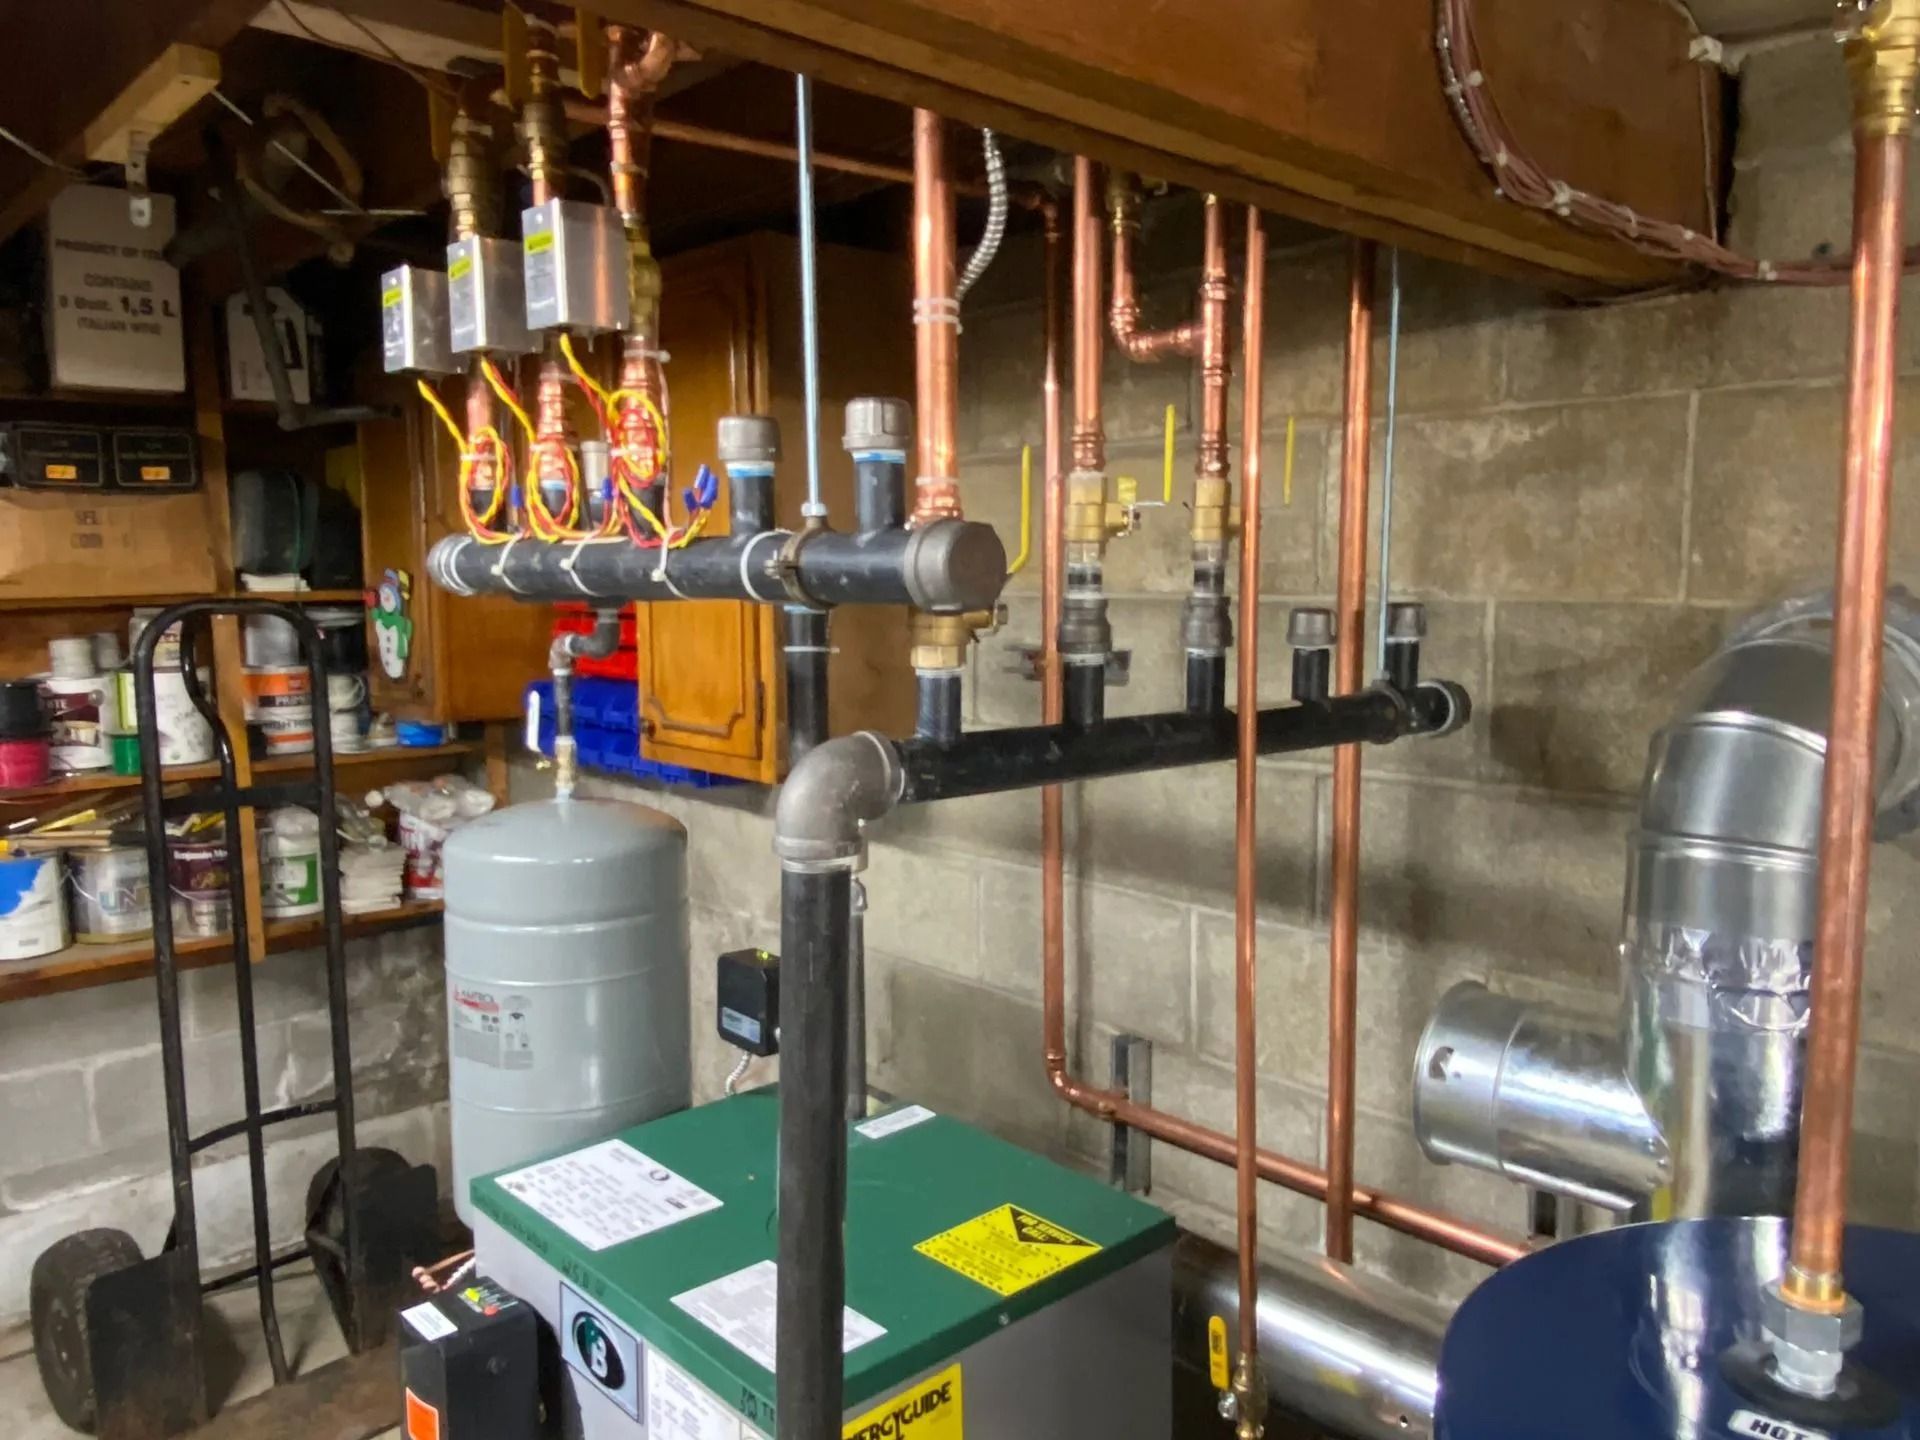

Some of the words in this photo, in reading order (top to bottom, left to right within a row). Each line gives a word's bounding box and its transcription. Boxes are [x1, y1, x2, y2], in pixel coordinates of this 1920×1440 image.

[120, 295, 153, 317] 1,5
[162, 299, 177, 317] L
[1749, 1418, 1809, 1440] HOT
